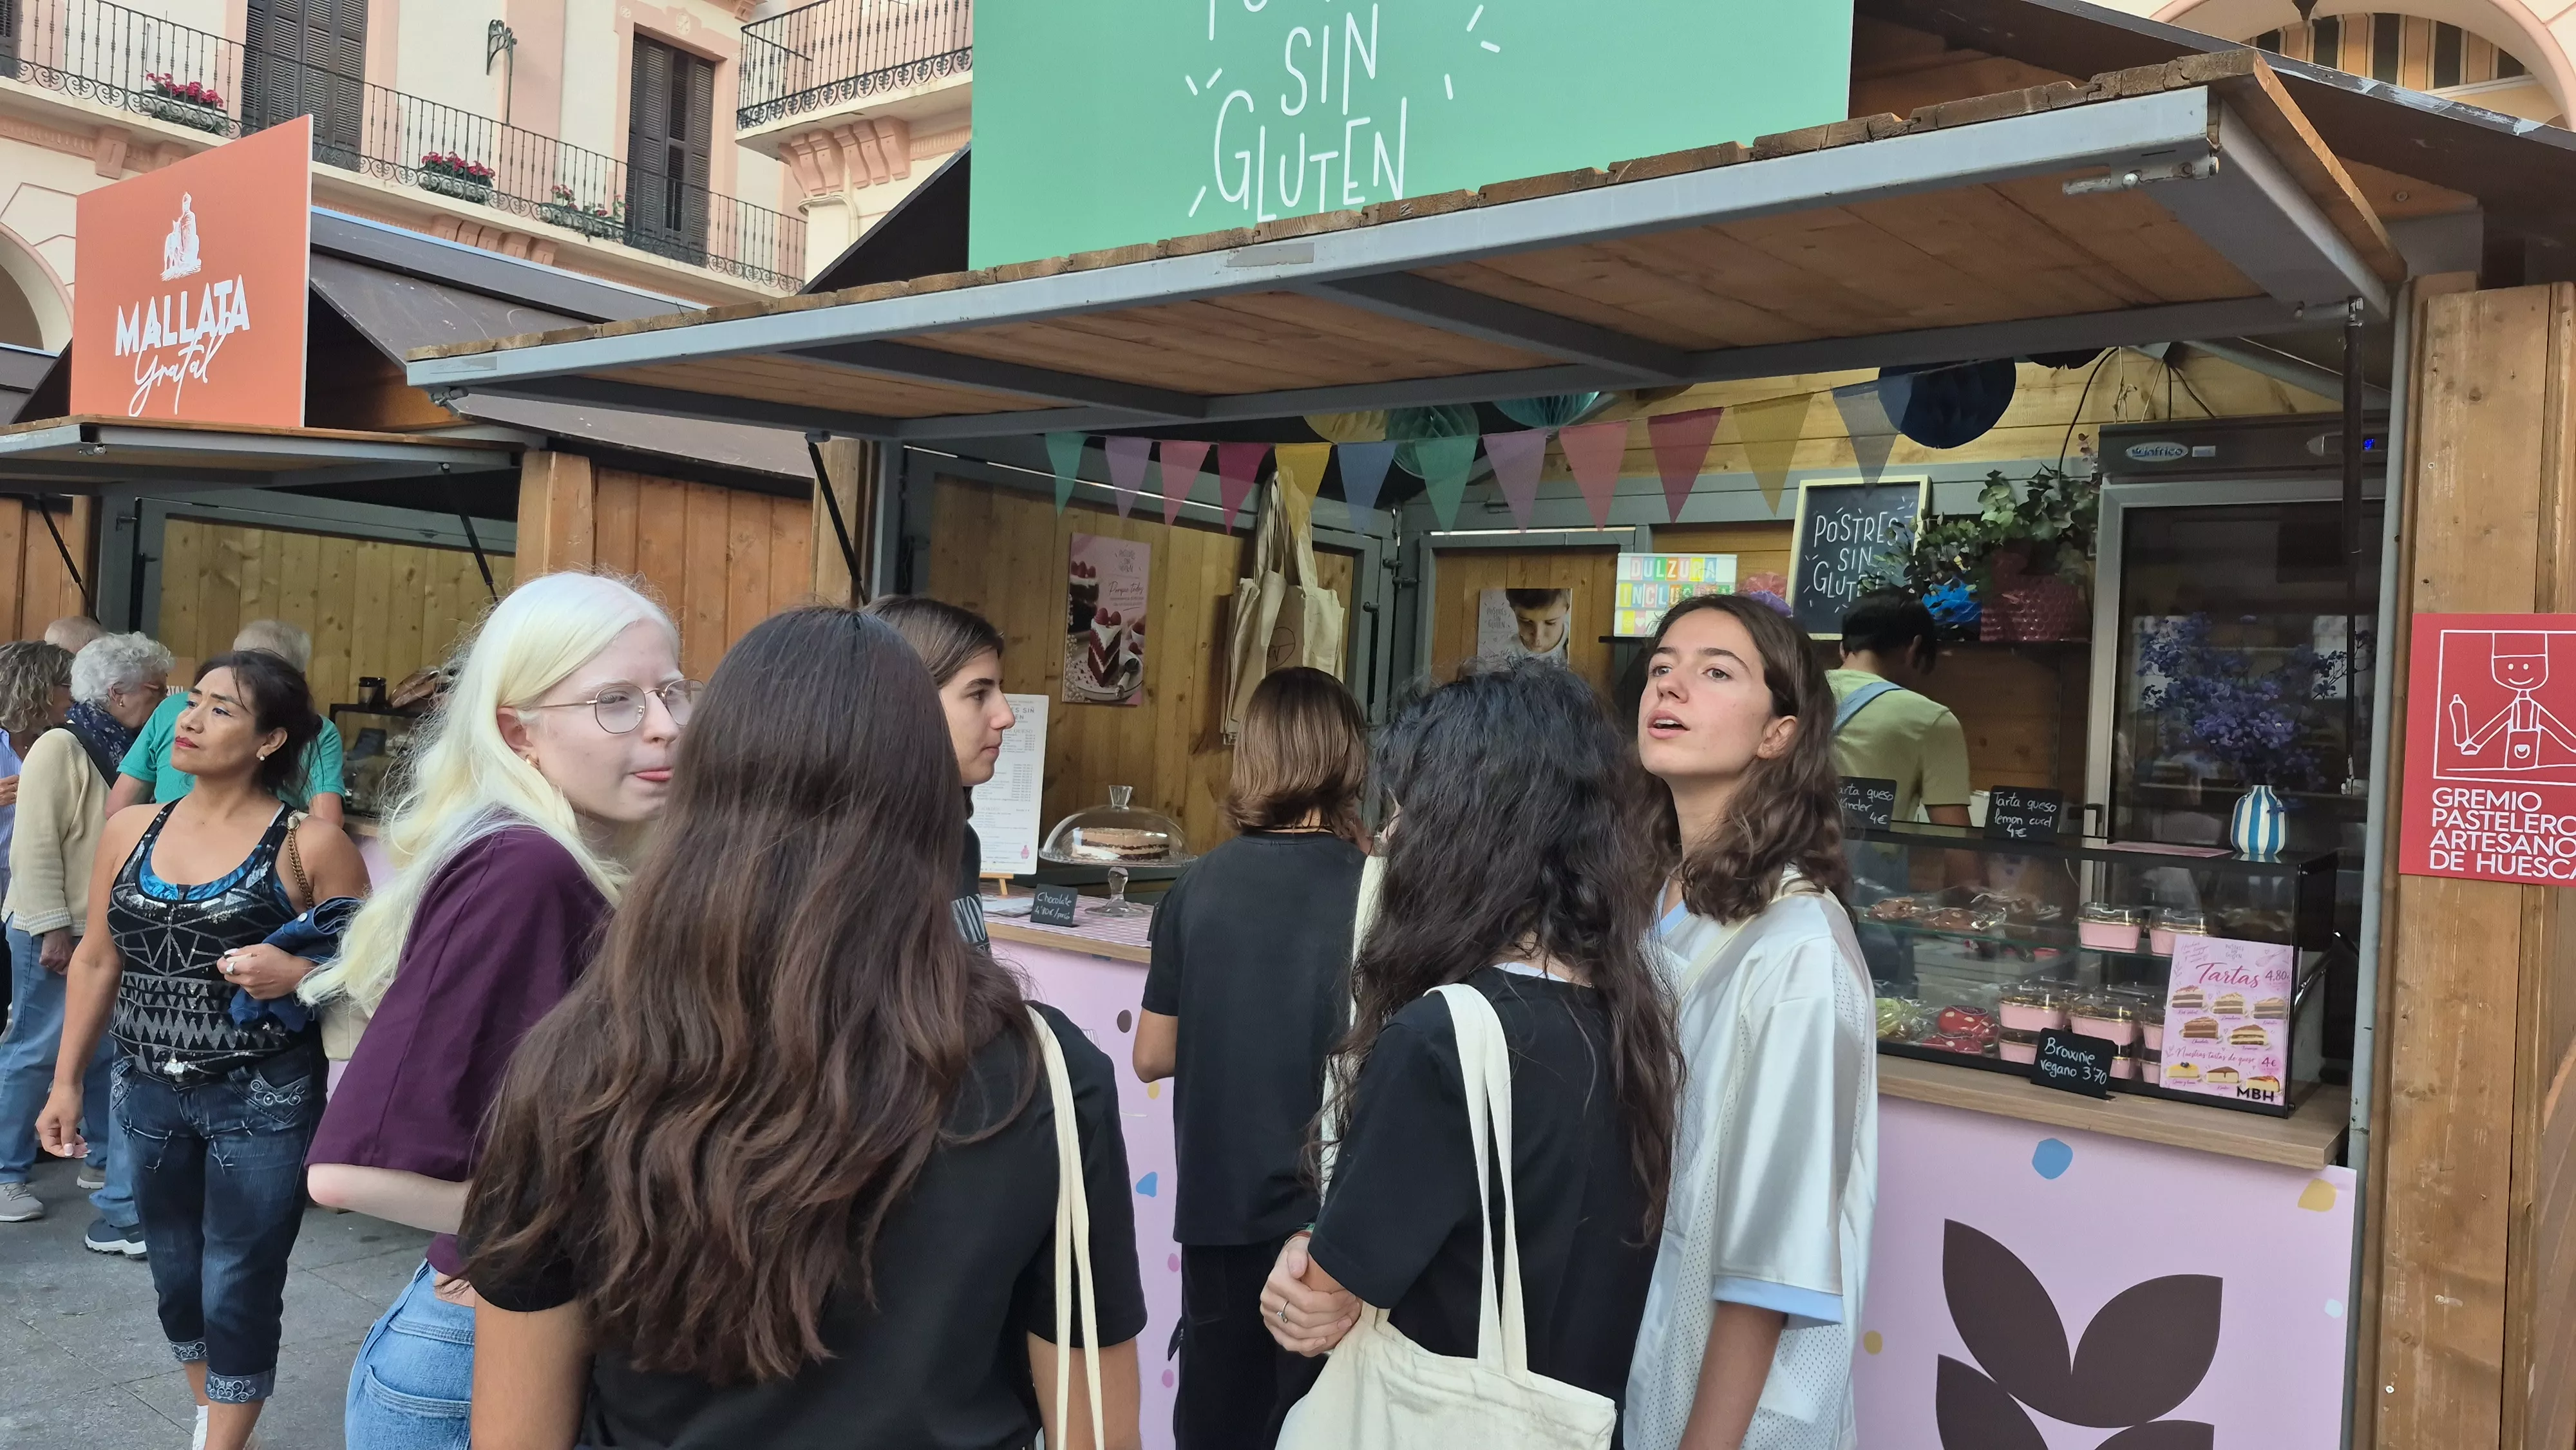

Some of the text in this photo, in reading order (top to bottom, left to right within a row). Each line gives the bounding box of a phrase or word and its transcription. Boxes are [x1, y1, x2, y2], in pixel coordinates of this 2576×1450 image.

[1280, 3, 1378, 116] SIN
[1214, 89, 1407, 222] GLUTEN
[115, 274, 250, 357] MALLATA
[1814, 511, 1899, 548] POSTRES
[1631, 559, 1717, 579] DULZURA
[1837, 546, 1872, 574] SIN
[1839, 783, 1893, 802] arta queso
[1993, 792, 2057, 812] Tarta queso
[2432, 787, 2543, 813] GREMIO
[1840, 798, 1873, 811] Kinder
[1870, 811, 1888, 824] 4€
[1994, 807, 2023, 825] lemon
[2006, 824, 2027, 838] 4€
[2429, 849, 2465, 872] DE
[1037, 892, 1072, 907] Chocolate
[2195, 962, 2259, 988] Tartas
[2044, 1037, 2095, 1065] Brownie
[2176, 1048, 2255, 1066] Nuestras tartas de queso
[2040, 1059, 2077, 1077] vegano
[2261, 1057, 2277, 1067] 4€
[2236, 1086, 2274, 1102] MBH
